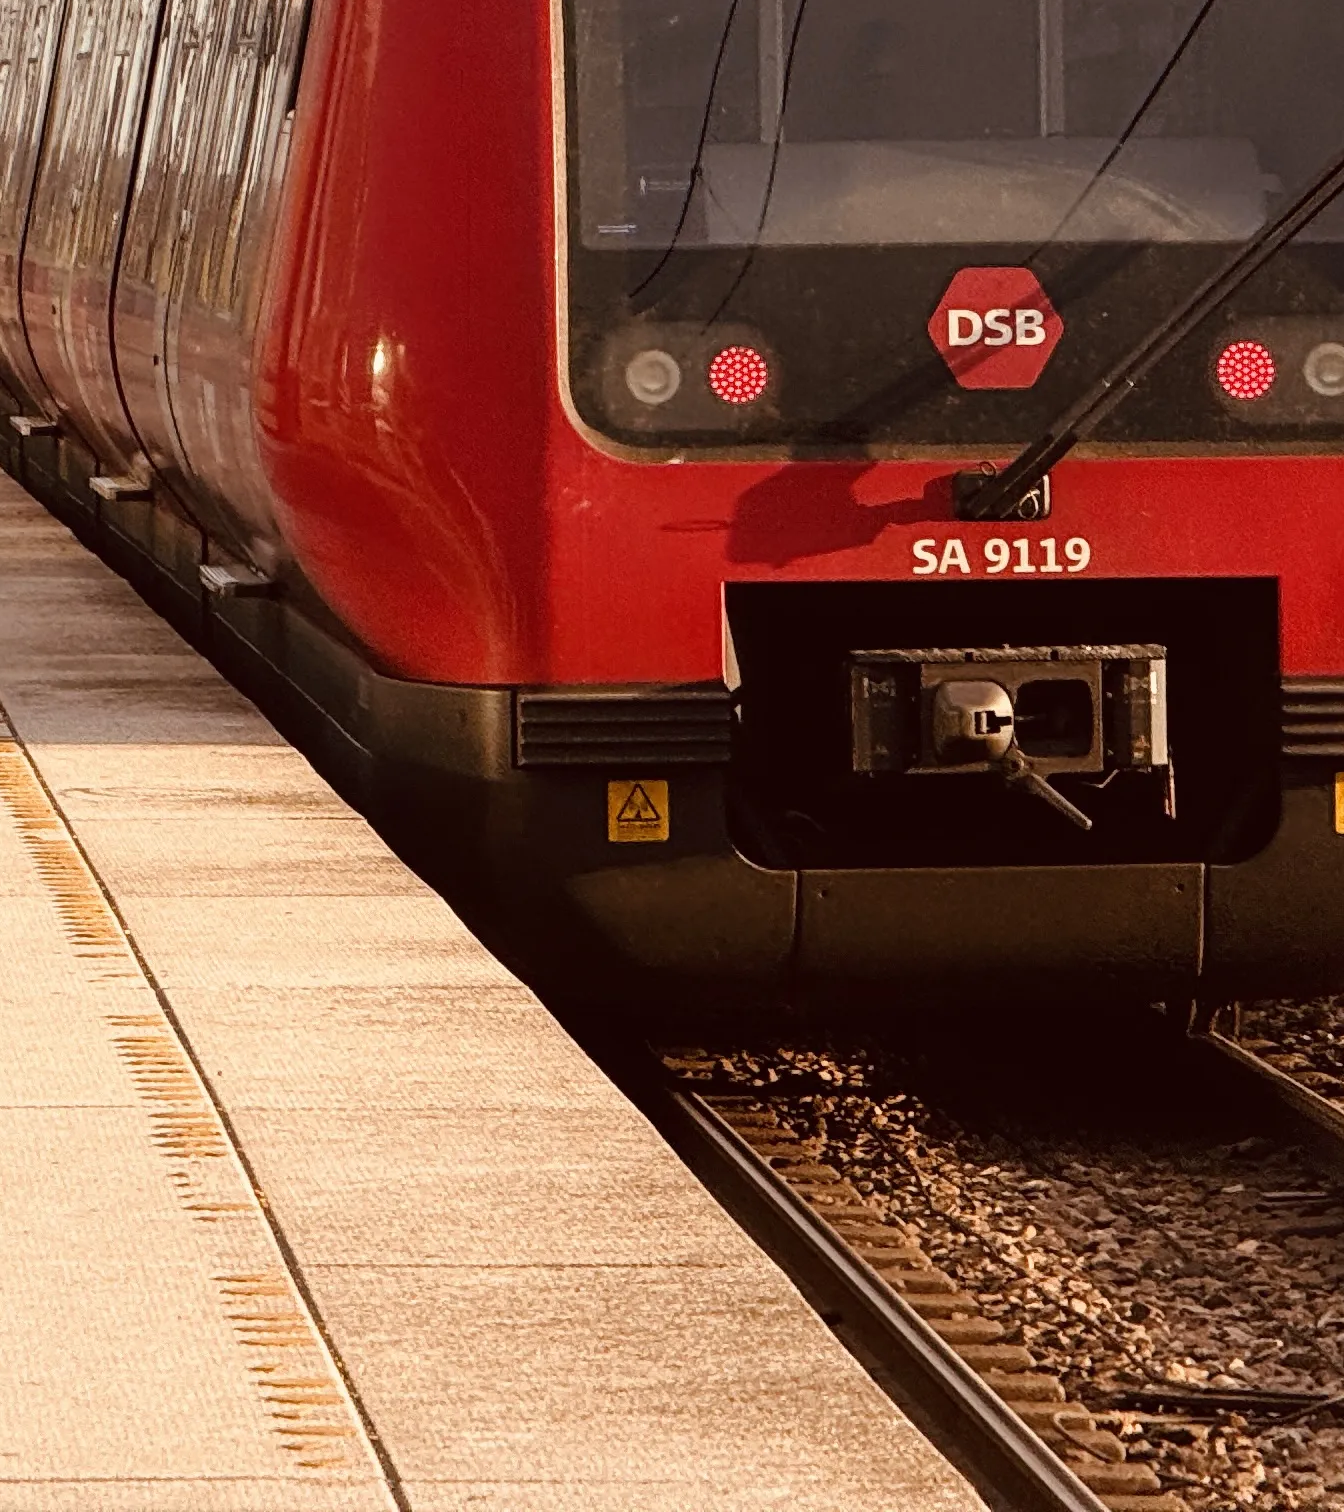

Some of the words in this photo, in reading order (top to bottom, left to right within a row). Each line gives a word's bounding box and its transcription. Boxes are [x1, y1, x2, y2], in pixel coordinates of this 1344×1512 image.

[948, 309, 1046, 346] DSB
[912, 538, 971, 574] SA
[984, 537, 1091, 574] 9119
